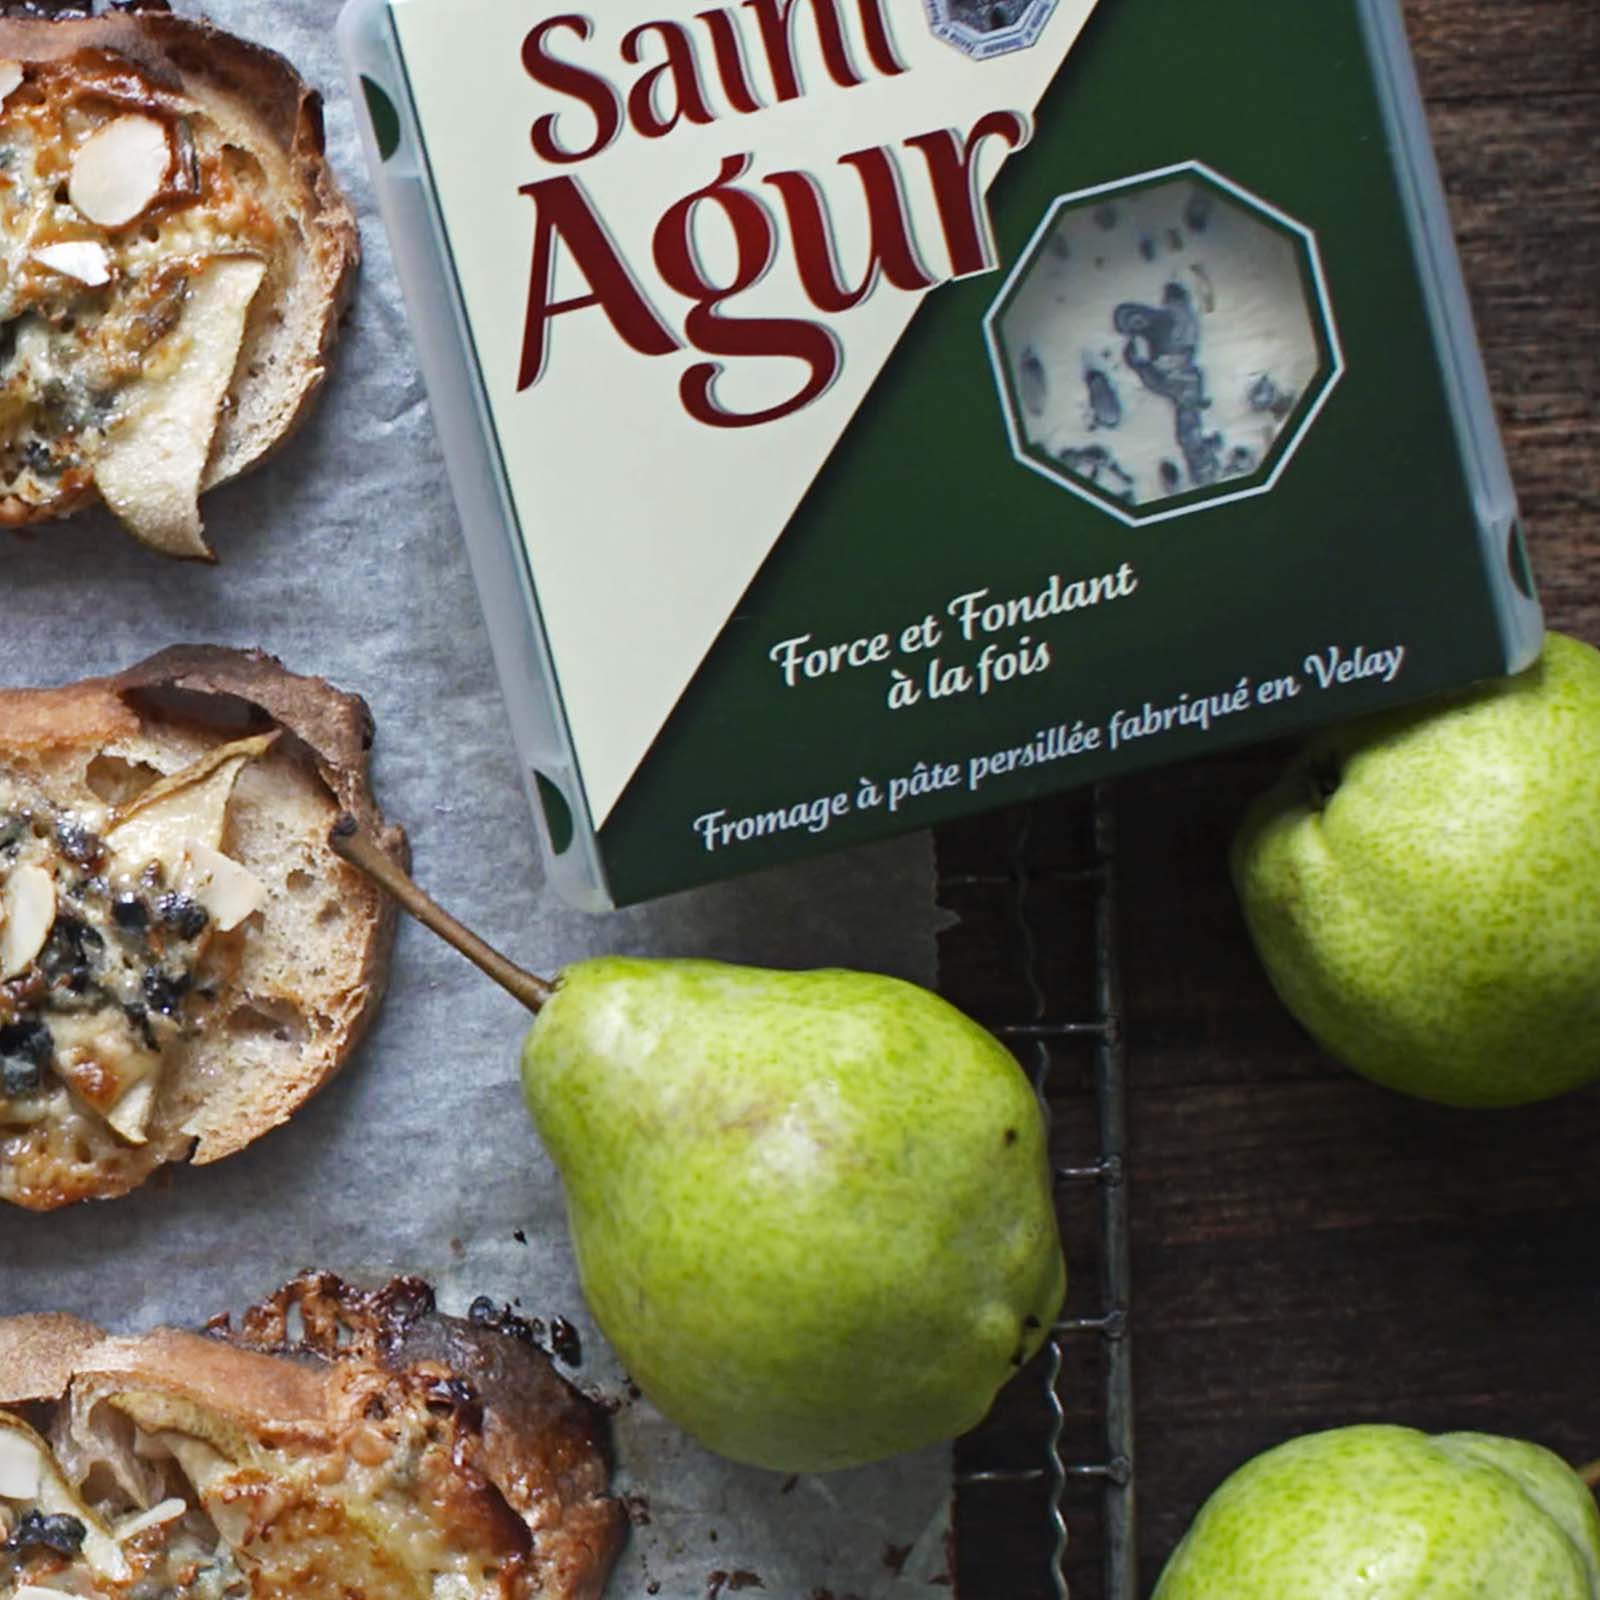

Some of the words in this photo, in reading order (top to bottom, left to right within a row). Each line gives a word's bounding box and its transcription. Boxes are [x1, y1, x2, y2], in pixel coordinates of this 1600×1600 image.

[516, 110, 1032, 428] Agur
[769, 633, 891, 687] Force
[900, 615, 942, 653] et
[947, 563, 1138, 641] Fondant
[887, 669, 922, 710] à
[928, 658, 973, 699] la
[977, 636, 1051, 694] fois
[693, 790, 849, 852] Fromage
[856, 777, 883, 810] à
[888, 762, 961, 812] pâte
[969, 720, 1101, 791] persillée
[1109, 677, 1250, 750] fabriqué
[1257, 676, 1300, 704] en
[1304, 644, 1405, 689] Velay
